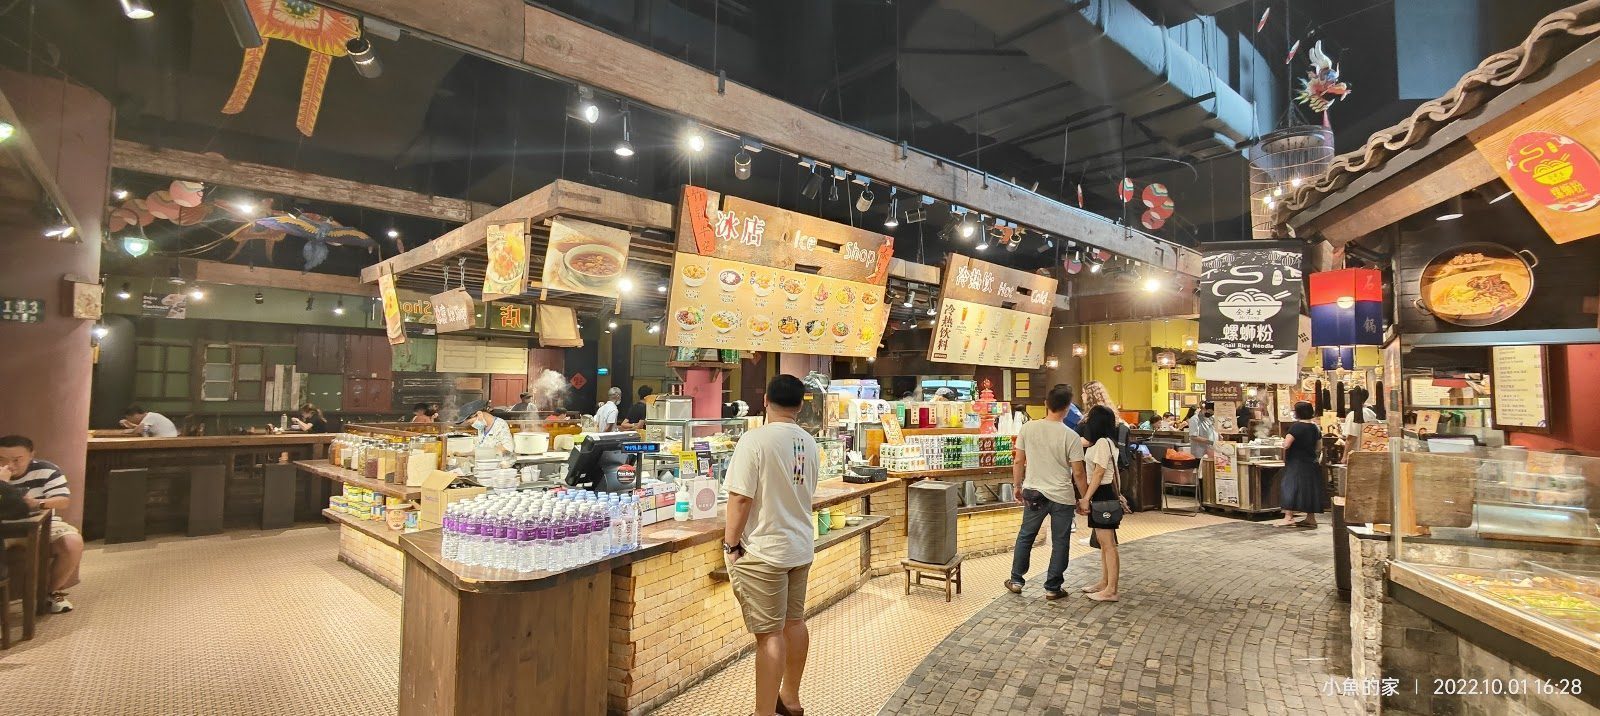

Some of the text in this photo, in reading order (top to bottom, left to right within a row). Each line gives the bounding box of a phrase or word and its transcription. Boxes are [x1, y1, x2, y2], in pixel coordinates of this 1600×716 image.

[715, 210, 765, 247] 冰店
[793, 229, 817, 252] Ice
[843, 241, 876, 269] Shop
[997, 281, 1049, 305] Hot Cold
[937, 304, 956, 351] 冷热饮料
